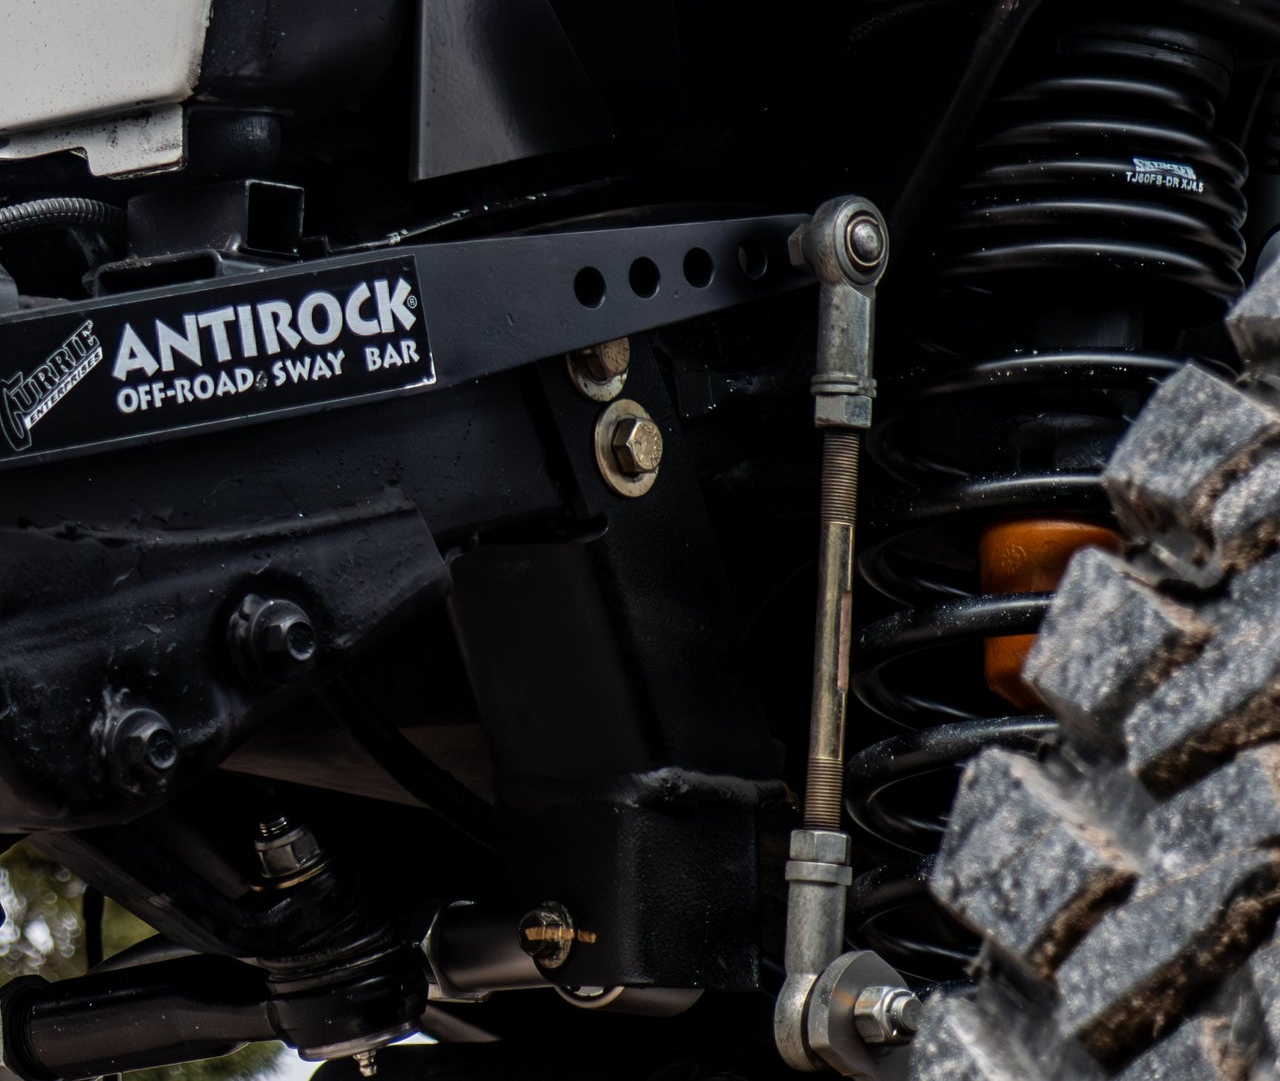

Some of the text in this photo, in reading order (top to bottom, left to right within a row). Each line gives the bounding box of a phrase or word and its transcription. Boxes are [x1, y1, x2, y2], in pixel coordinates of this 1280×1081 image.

[28, 348, 103, 425] ENTERPRISES
[116, 339, 420, 414] OFF-ROAD SWAY BAR
